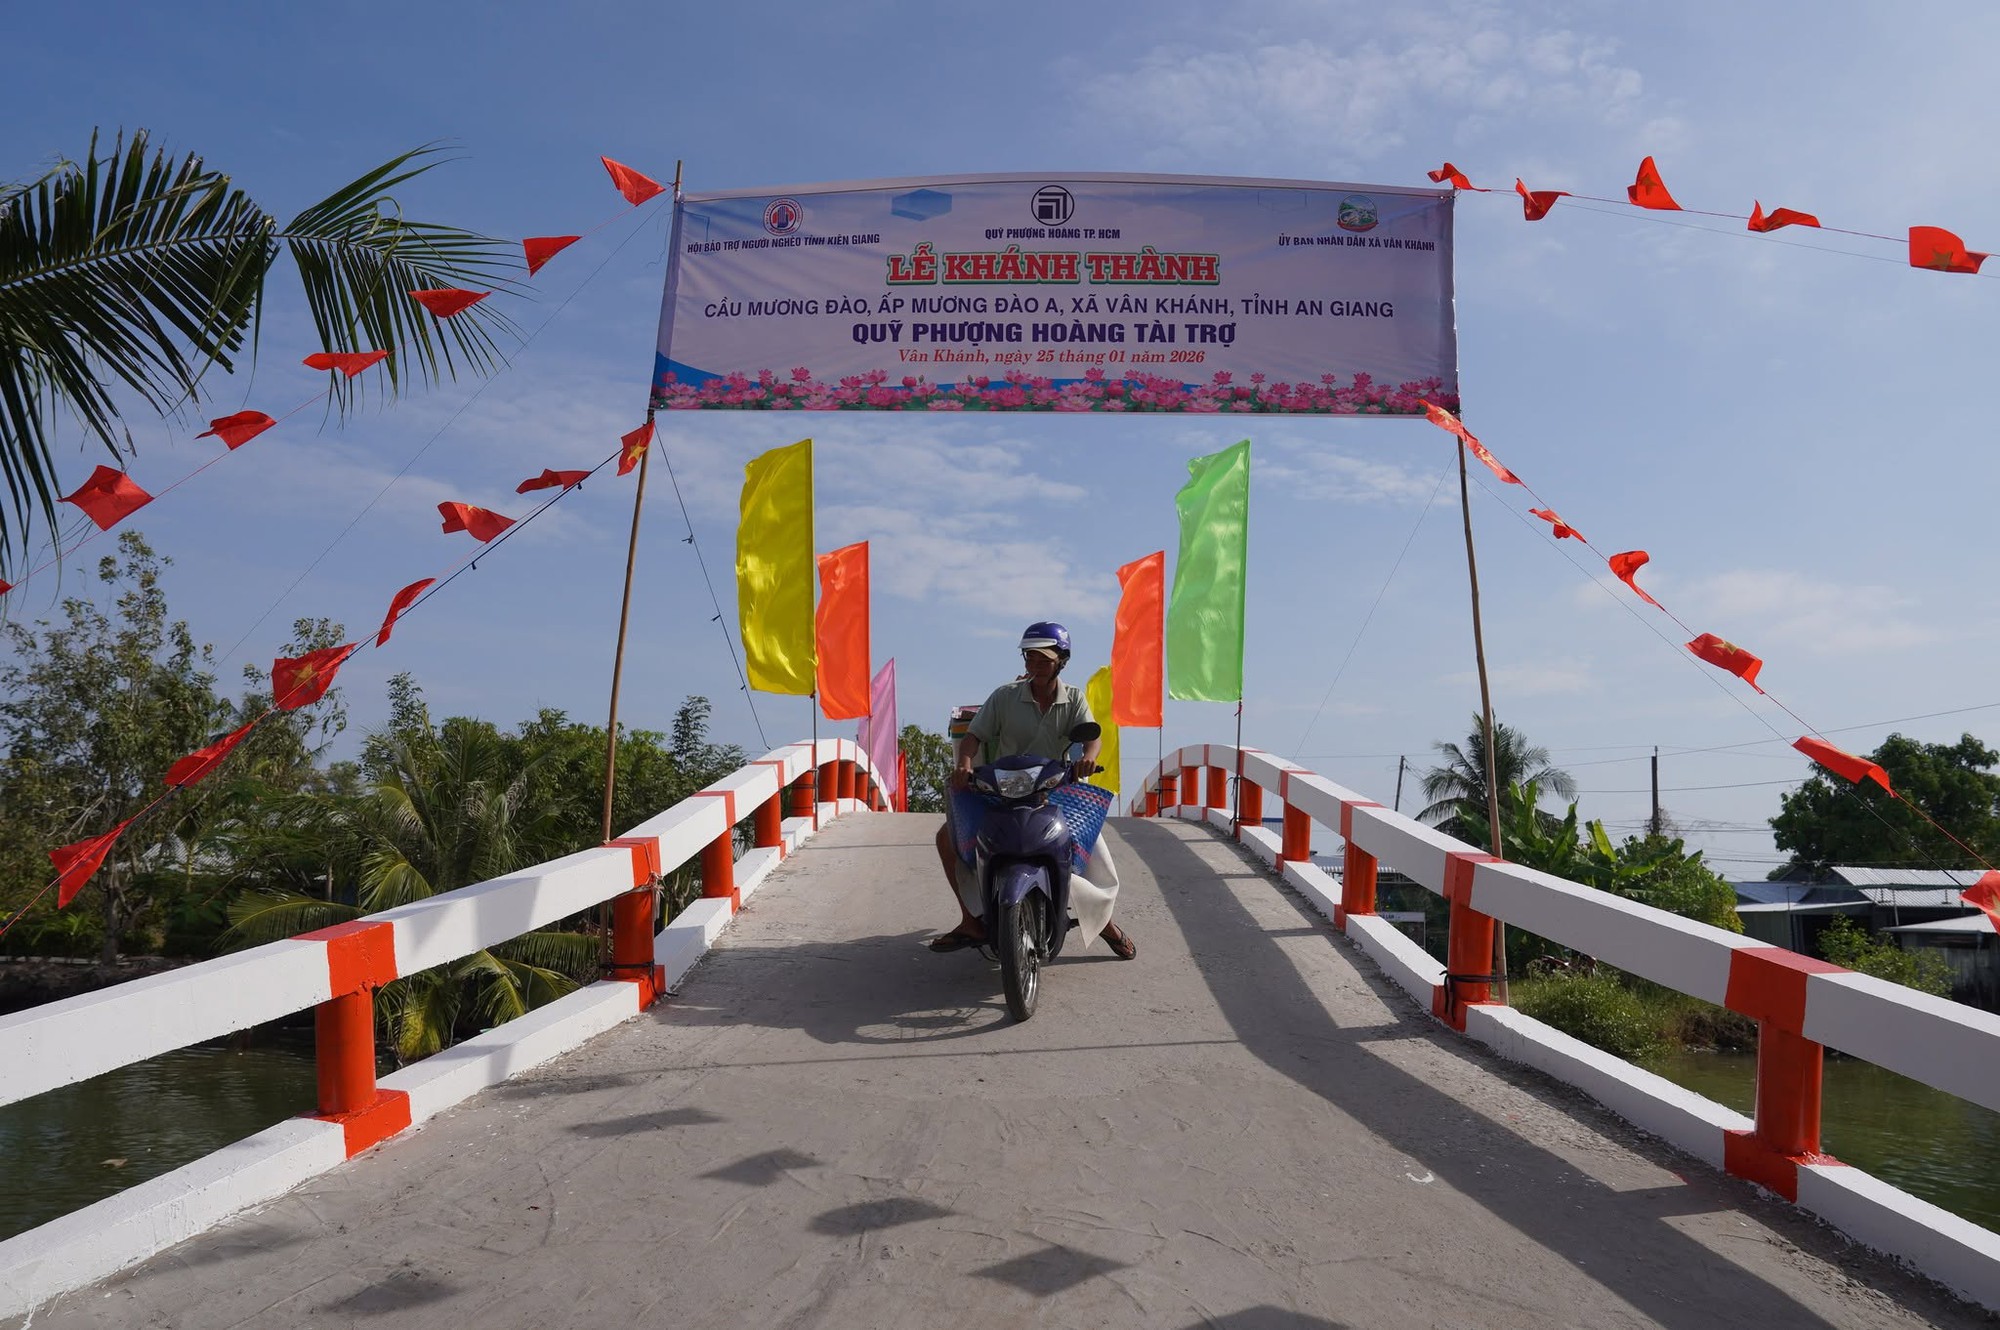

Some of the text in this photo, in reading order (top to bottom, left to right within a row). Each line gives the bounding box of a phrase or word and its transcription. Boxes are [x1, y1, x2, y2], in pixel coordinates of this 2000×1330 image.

[827, 234, 849, 245] KIÊN
[851, 233, 880, 244] GIANG
[1006, 227, 1045, 239] PHƯỢNG
[1083, 229, 1096, 239] TP.
[1098, 229, 1120, 239] HCM
[1278, 233, 1435, 251] ỦY BAN NHÂN DÂN XÃ VÂN KHÁNH
[888, 244, 1220, 283] LỄ KHÁNH THÀNH
[704, 292, 1393, 317] CẦU MƯƠNG ĐÀO, ẤP MƯƠNG ĐÀO A, XÃ VÂN KHÁNH, TỈNH AN GIANG
[852, 320, 1236, 347] QUỸ PHƯỢNG HOÀNG TÀI TRỢ
[899, 349, 1205, 364] Vân Khánh, ngày 25 tháng 01 năm 2026
